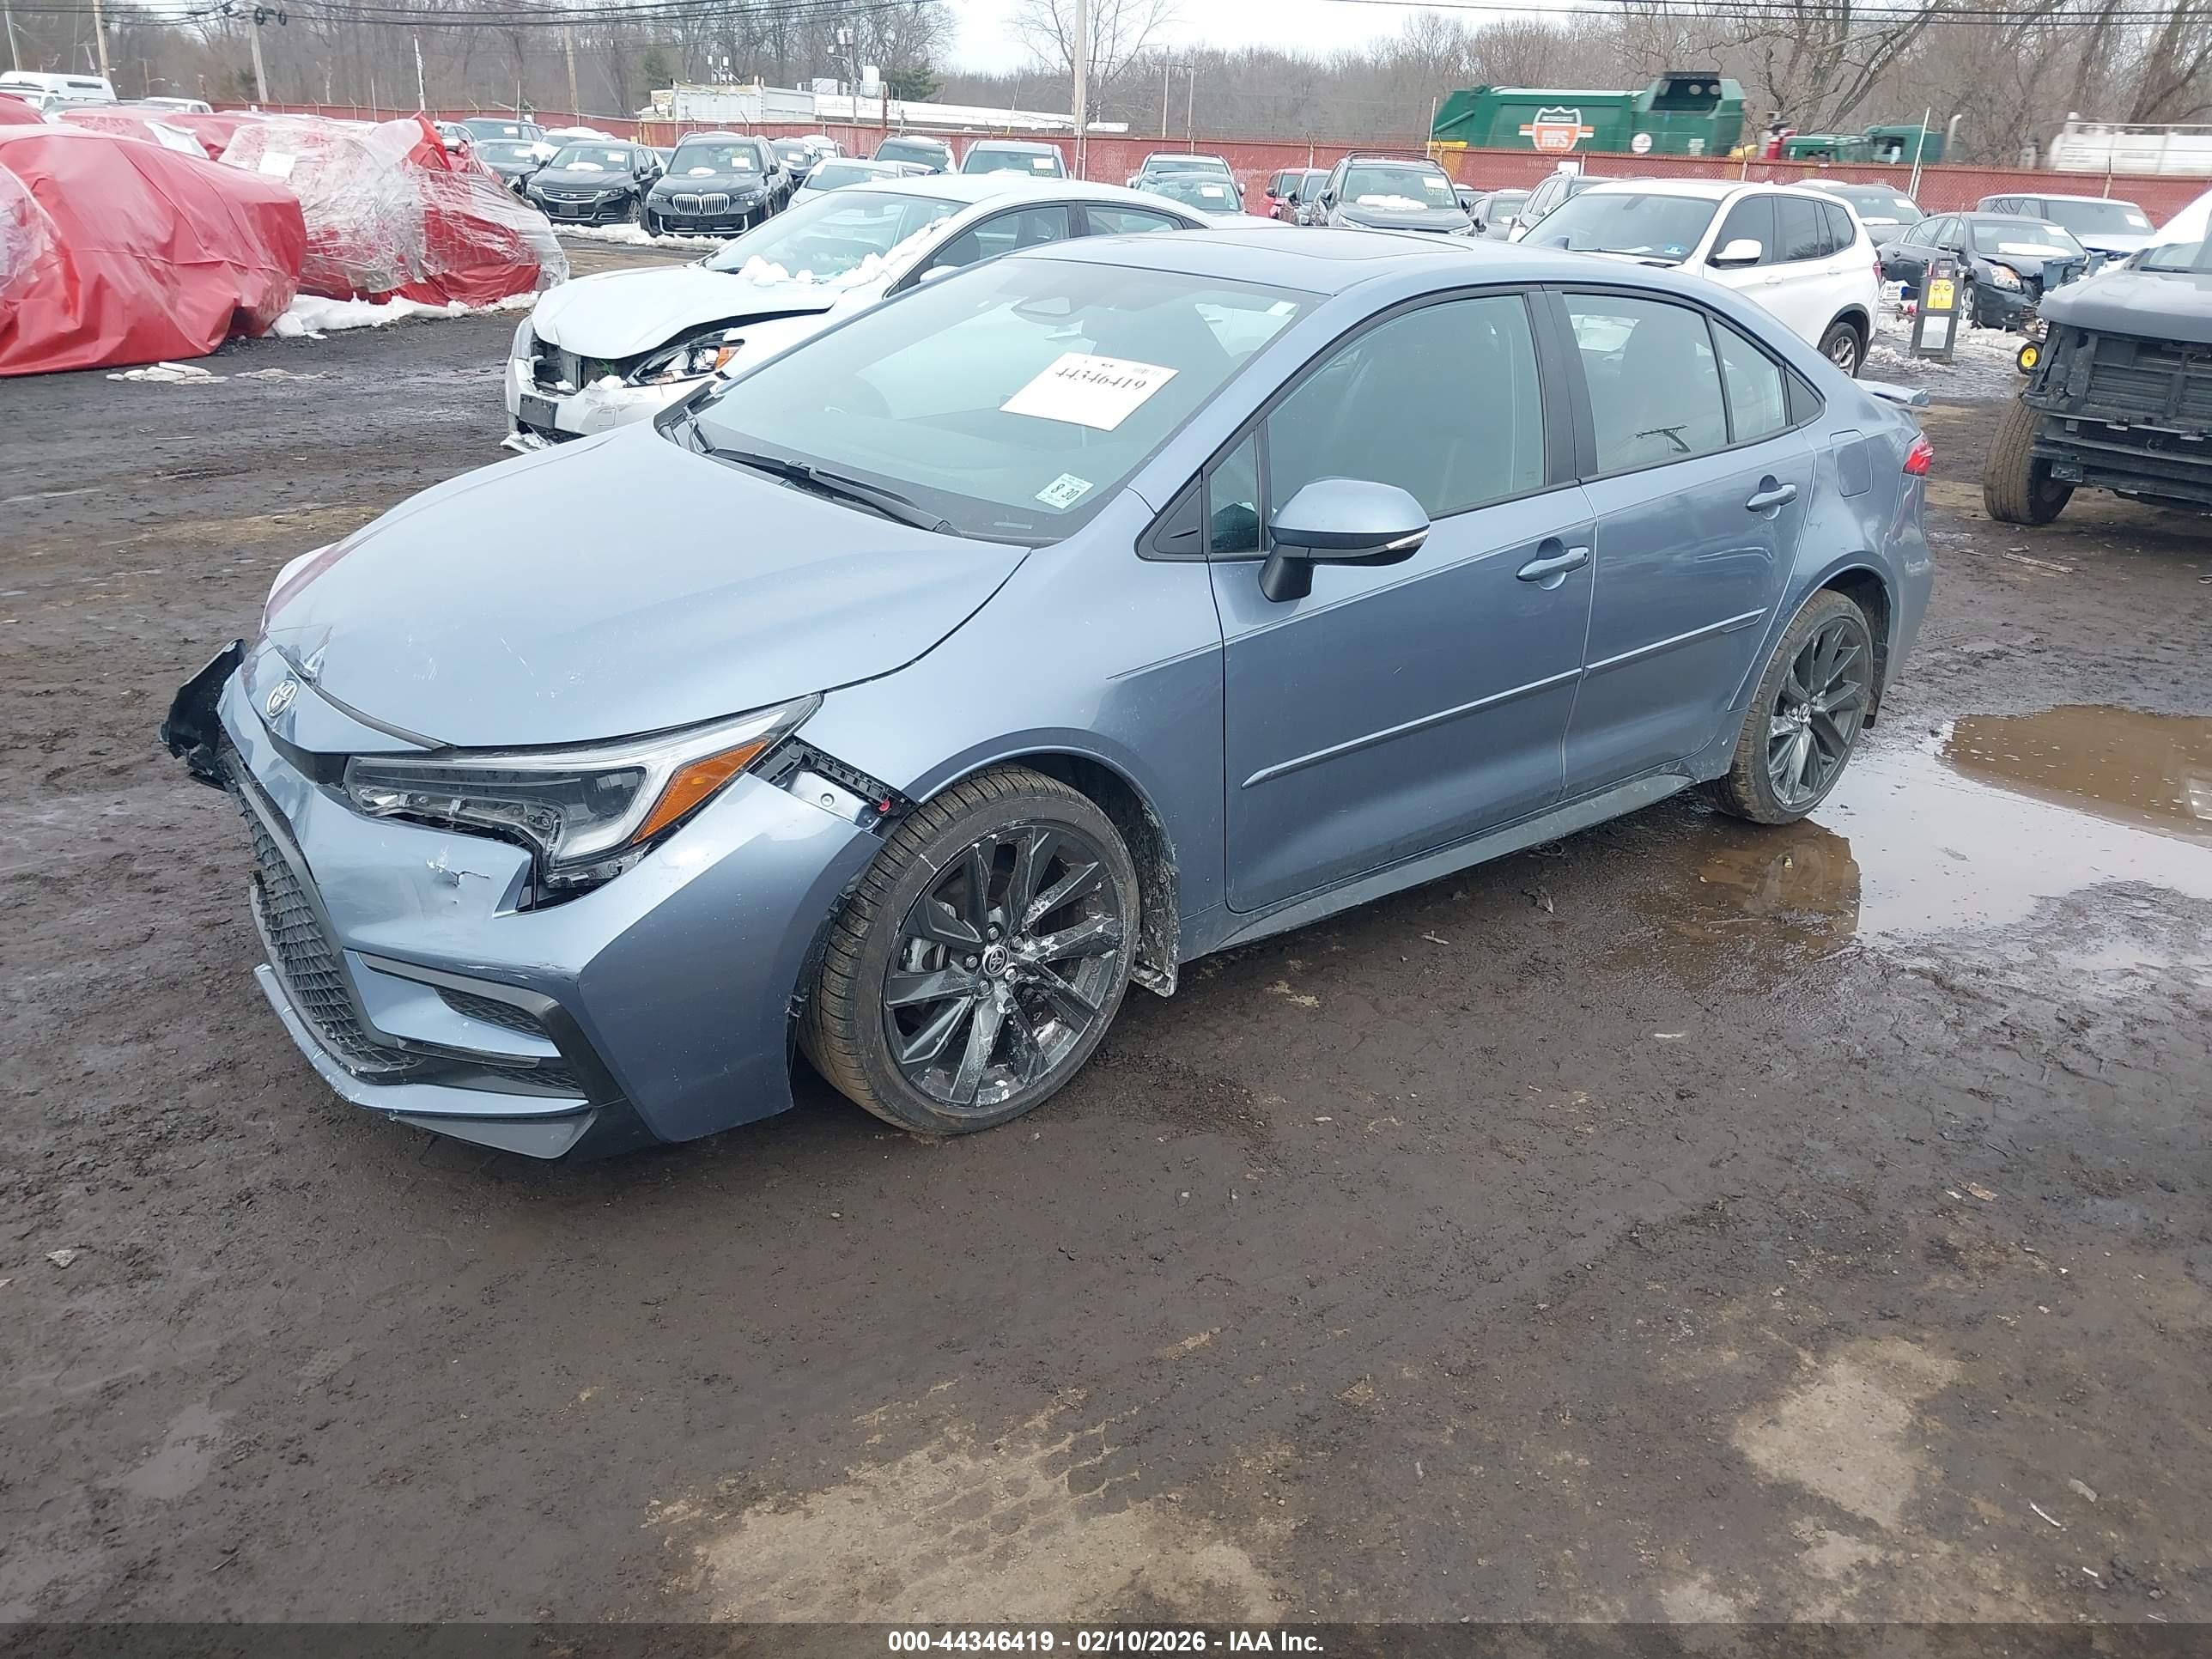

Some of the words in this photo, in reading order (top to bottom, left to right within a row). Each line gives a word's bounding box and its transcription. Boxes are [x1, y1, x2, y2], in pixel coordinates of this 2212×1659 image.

[1055, 368, 1147, 390] 44346419
[1050, 483, 1066, 494] 8
[1060, 488, 1080, 501] 30
